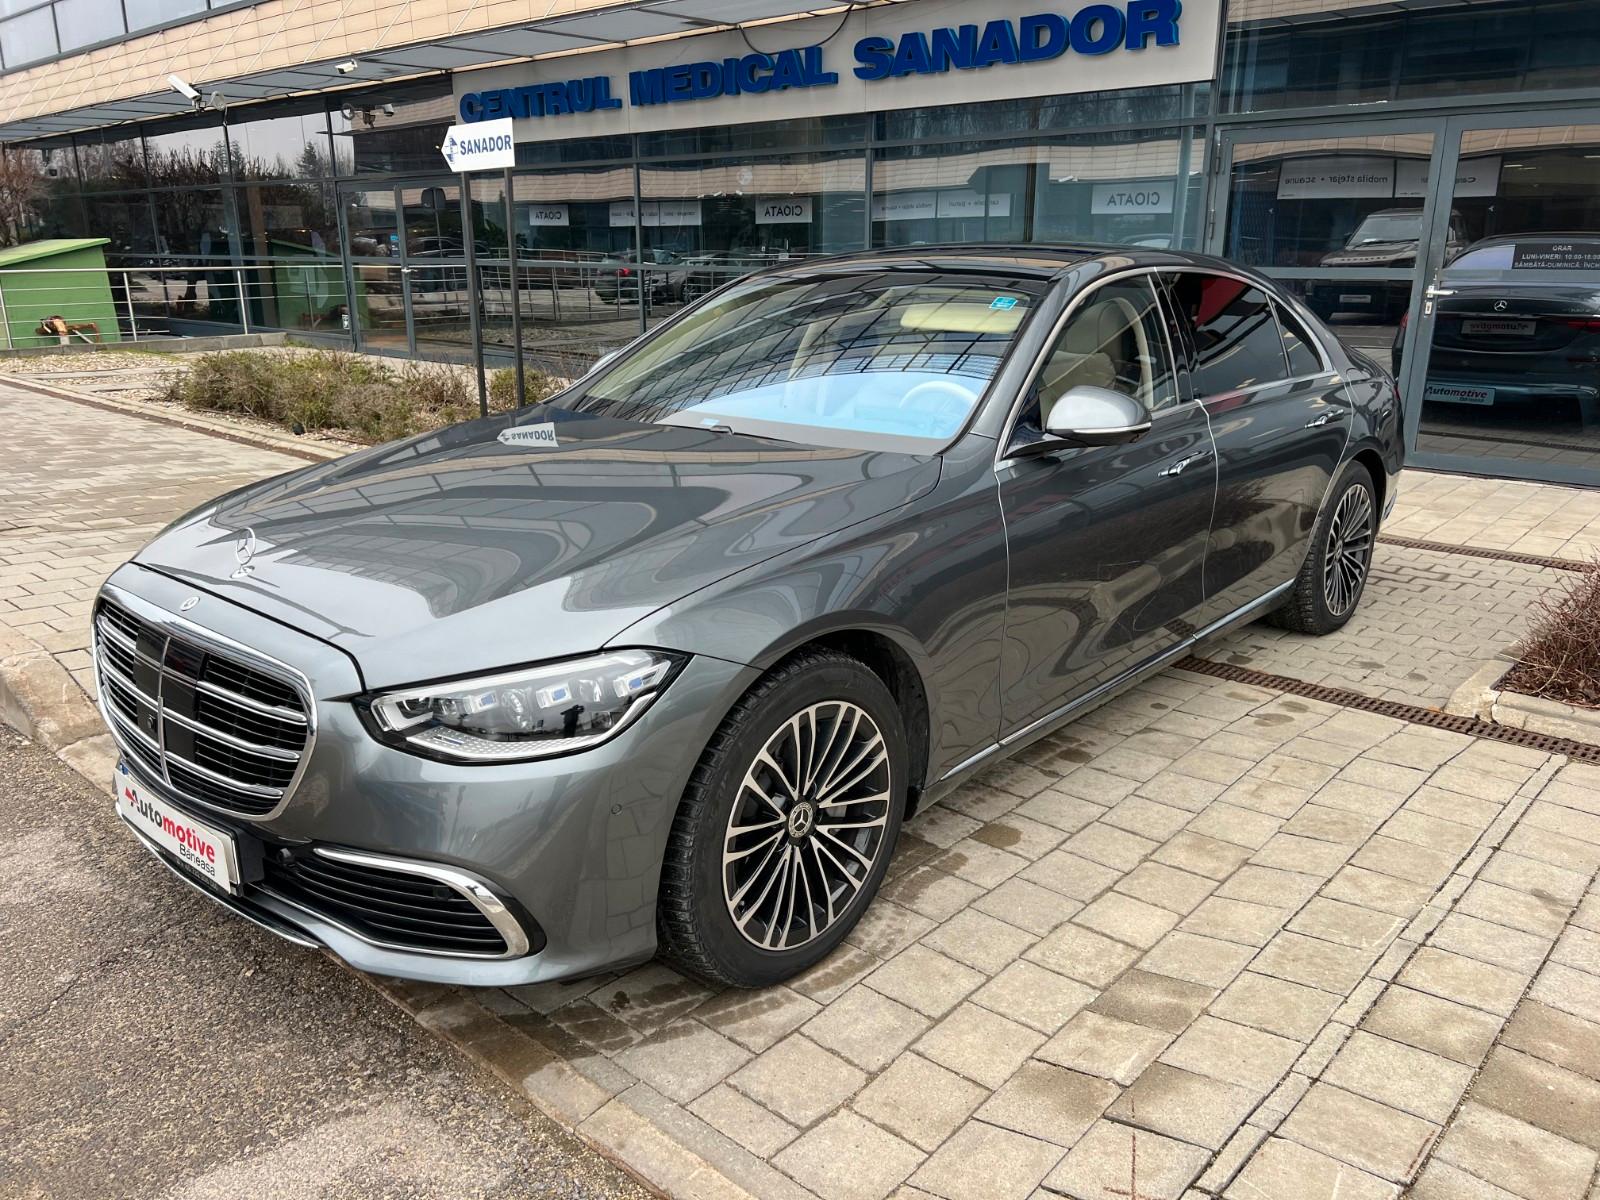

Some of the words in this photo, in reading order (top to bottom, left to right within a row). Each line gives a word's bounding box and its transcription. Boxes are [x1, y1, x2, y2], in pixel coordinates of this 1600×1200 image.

[460, 76, 622, 124] CENTRUL
[629, 46, 839, 106] MEDICAL
[853, 0, 1182, 81] SANADOR
[459, 134, 512, 156] SANADOR
[125, 785, 215, 865] Automotive
